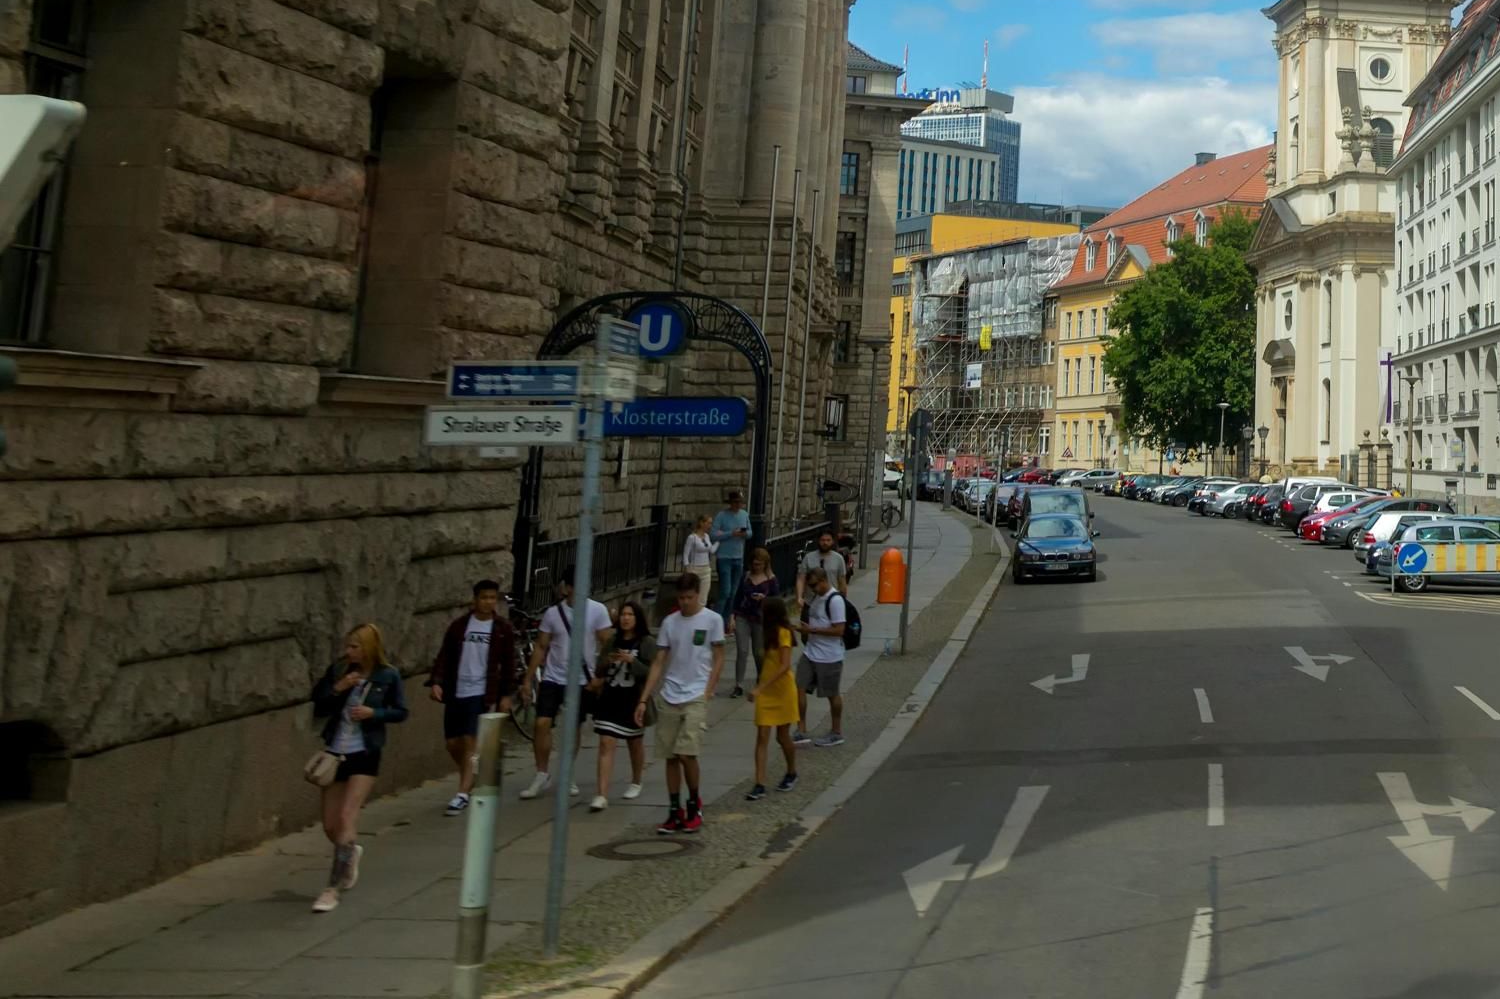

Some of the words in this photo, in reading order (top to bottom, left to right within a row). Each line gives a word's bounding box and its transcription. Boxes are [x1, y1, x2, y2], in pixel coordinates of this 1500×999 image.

[639, 314, 673, 351] U
[442, 415, 510, 433] Stralauer
[513, 415, 563, 437] Straße
[611, 407, 731, 426] Klosterstraße
